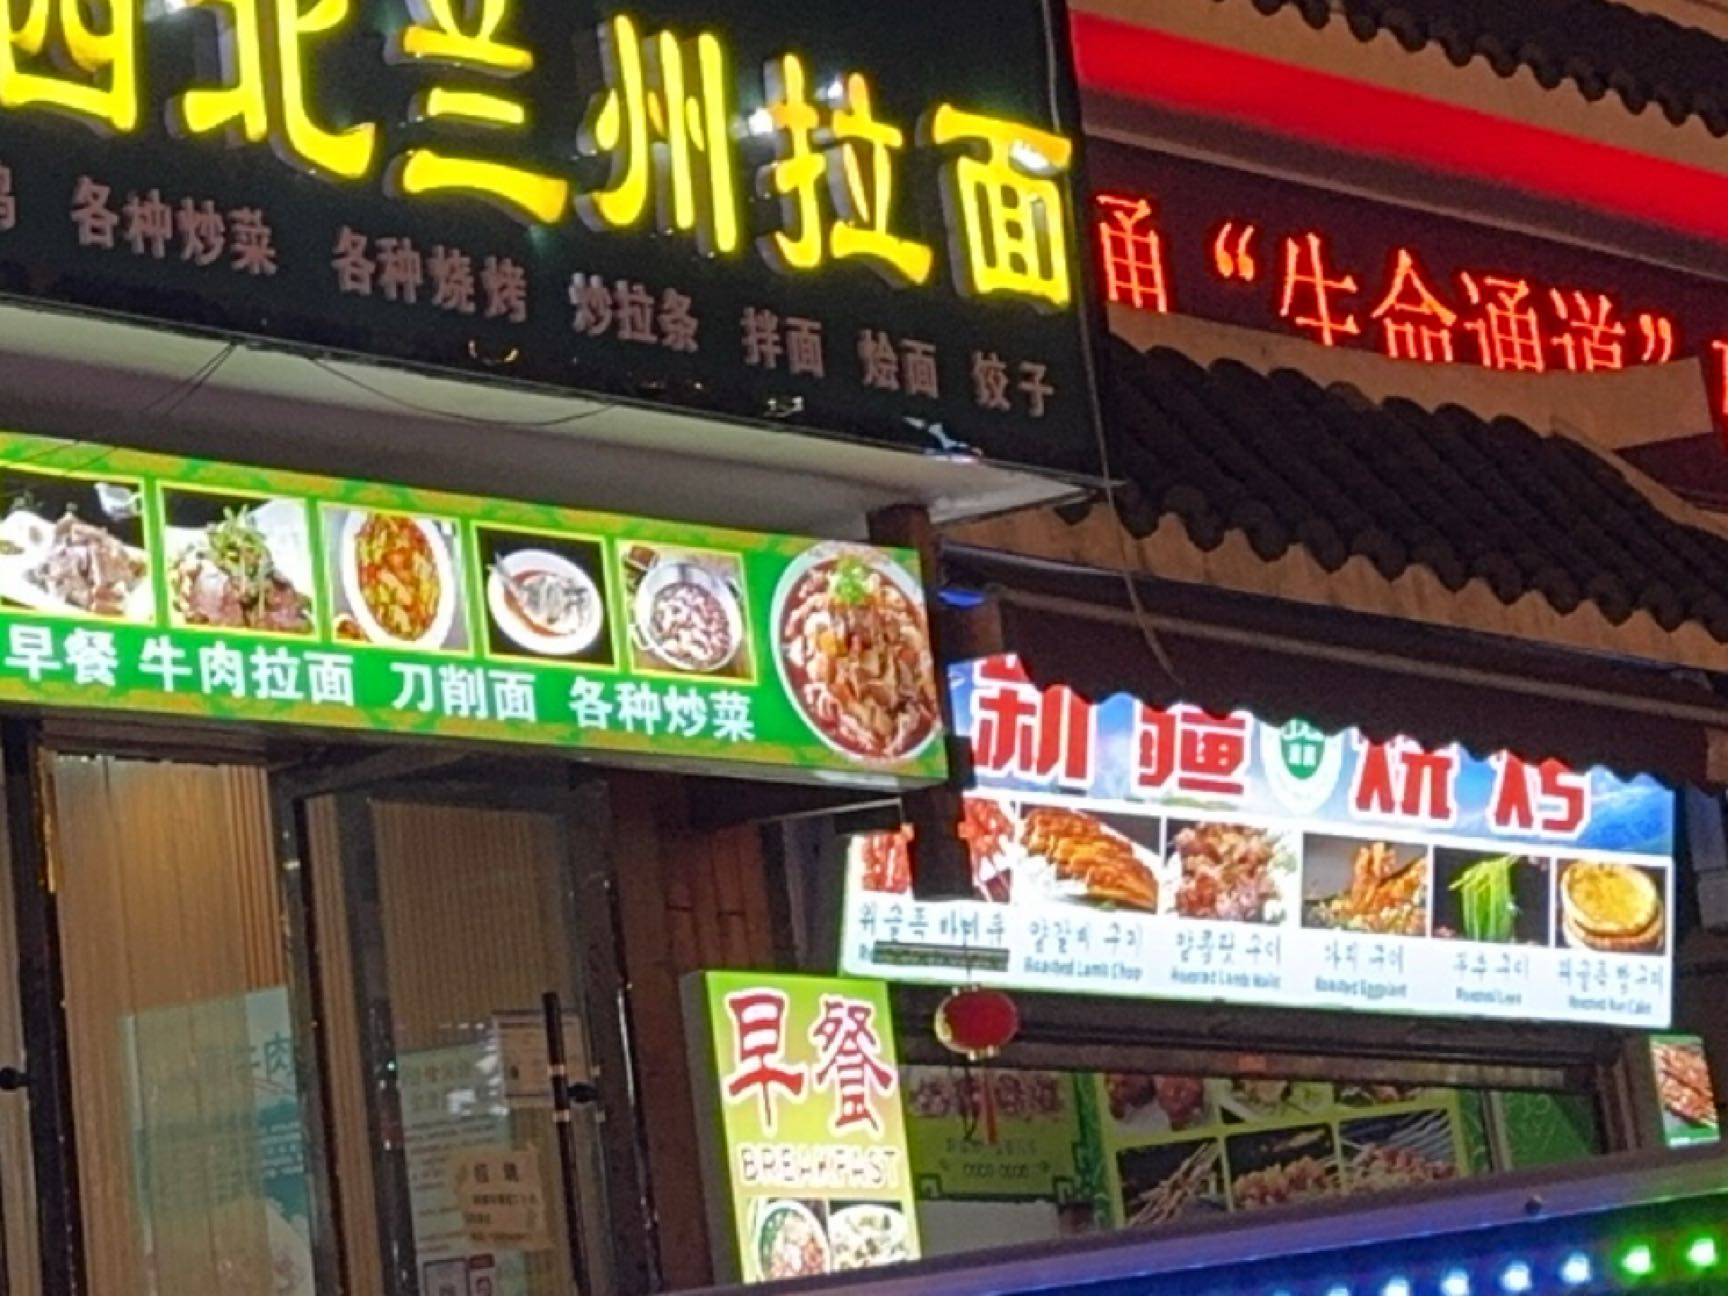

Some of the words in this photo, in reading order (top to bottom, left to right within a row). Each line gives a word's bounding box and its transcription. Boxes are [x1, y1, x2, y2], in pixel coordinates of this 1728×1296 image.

[71, 175, 278, 276] 各种炒菜
[331, 227, 528, 323] 各种烧烤
[569, 272, 700, 354] 炒拉条
[858, 329, 941, 399] 烩面
[5, 625, 118, 685] 早餐
[139, 638, 355, 705] 牛肉拉面
[392, 660, 536, 723] 刀削面
[569, 675, 757, 743] 各种炒菜
[726, 992, 895, 1132] 早餐
